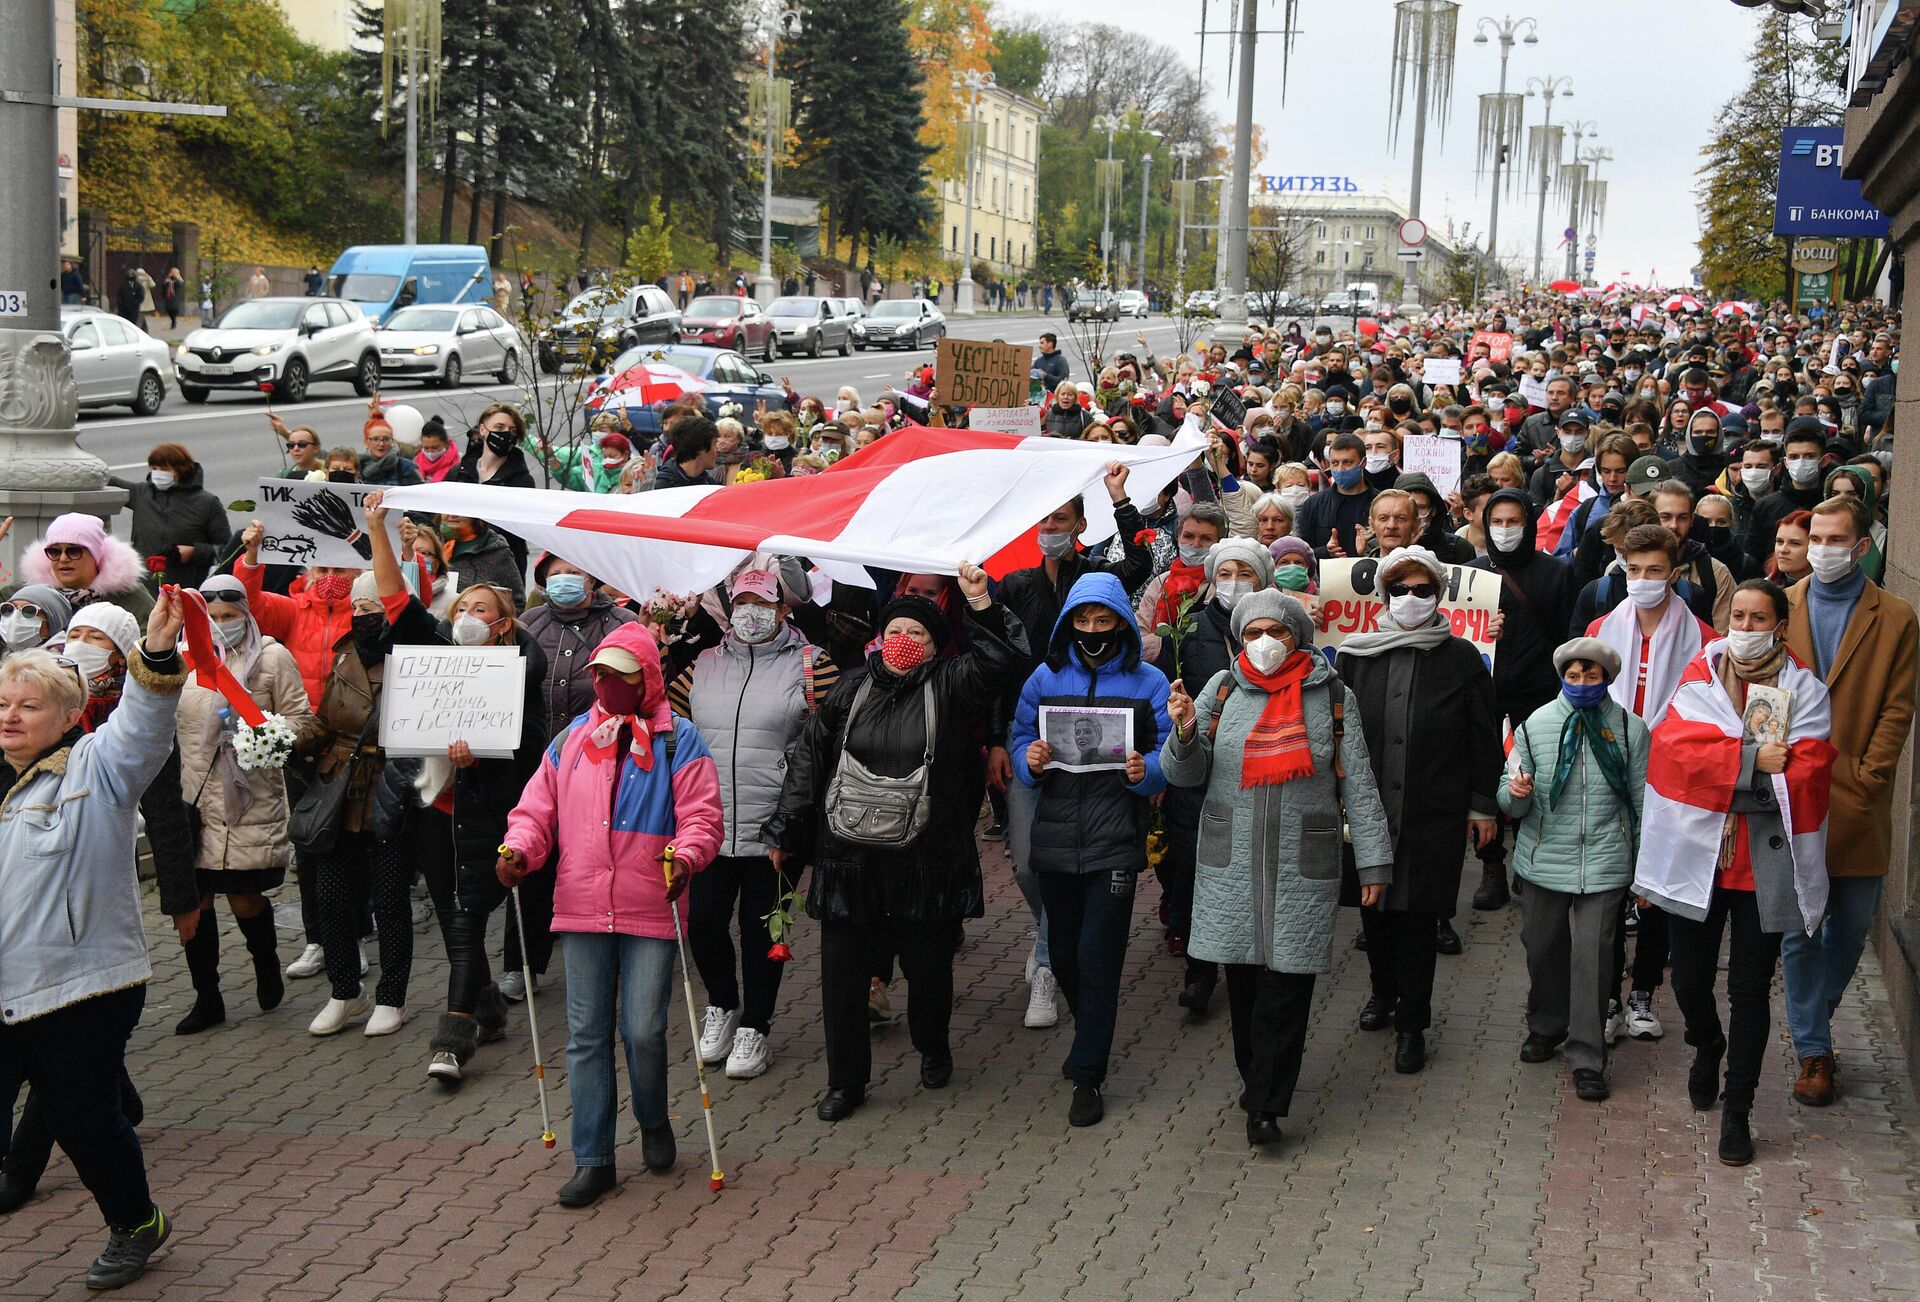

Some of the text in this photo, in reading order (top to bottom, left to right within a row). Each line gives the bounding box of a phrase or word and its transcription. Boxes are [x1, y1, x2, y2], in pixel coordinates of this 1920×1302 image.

[1811, 208, 1880, 221] БАНКОМАТ
[1476, 334, 1509, 346] STOP
[951, 343, 1021, 377] ЧЕСТНЫЕ
[951, 373, 1021, 408] ВЫБОРЫ
[986, 408, 1030, 418] ЗАРПЛАТА
[1415, 448, 1445, 457] КОЖНЫ
[259, 485, 297, 503] ТИК
[1319, 599, 1389, 633] РУК
